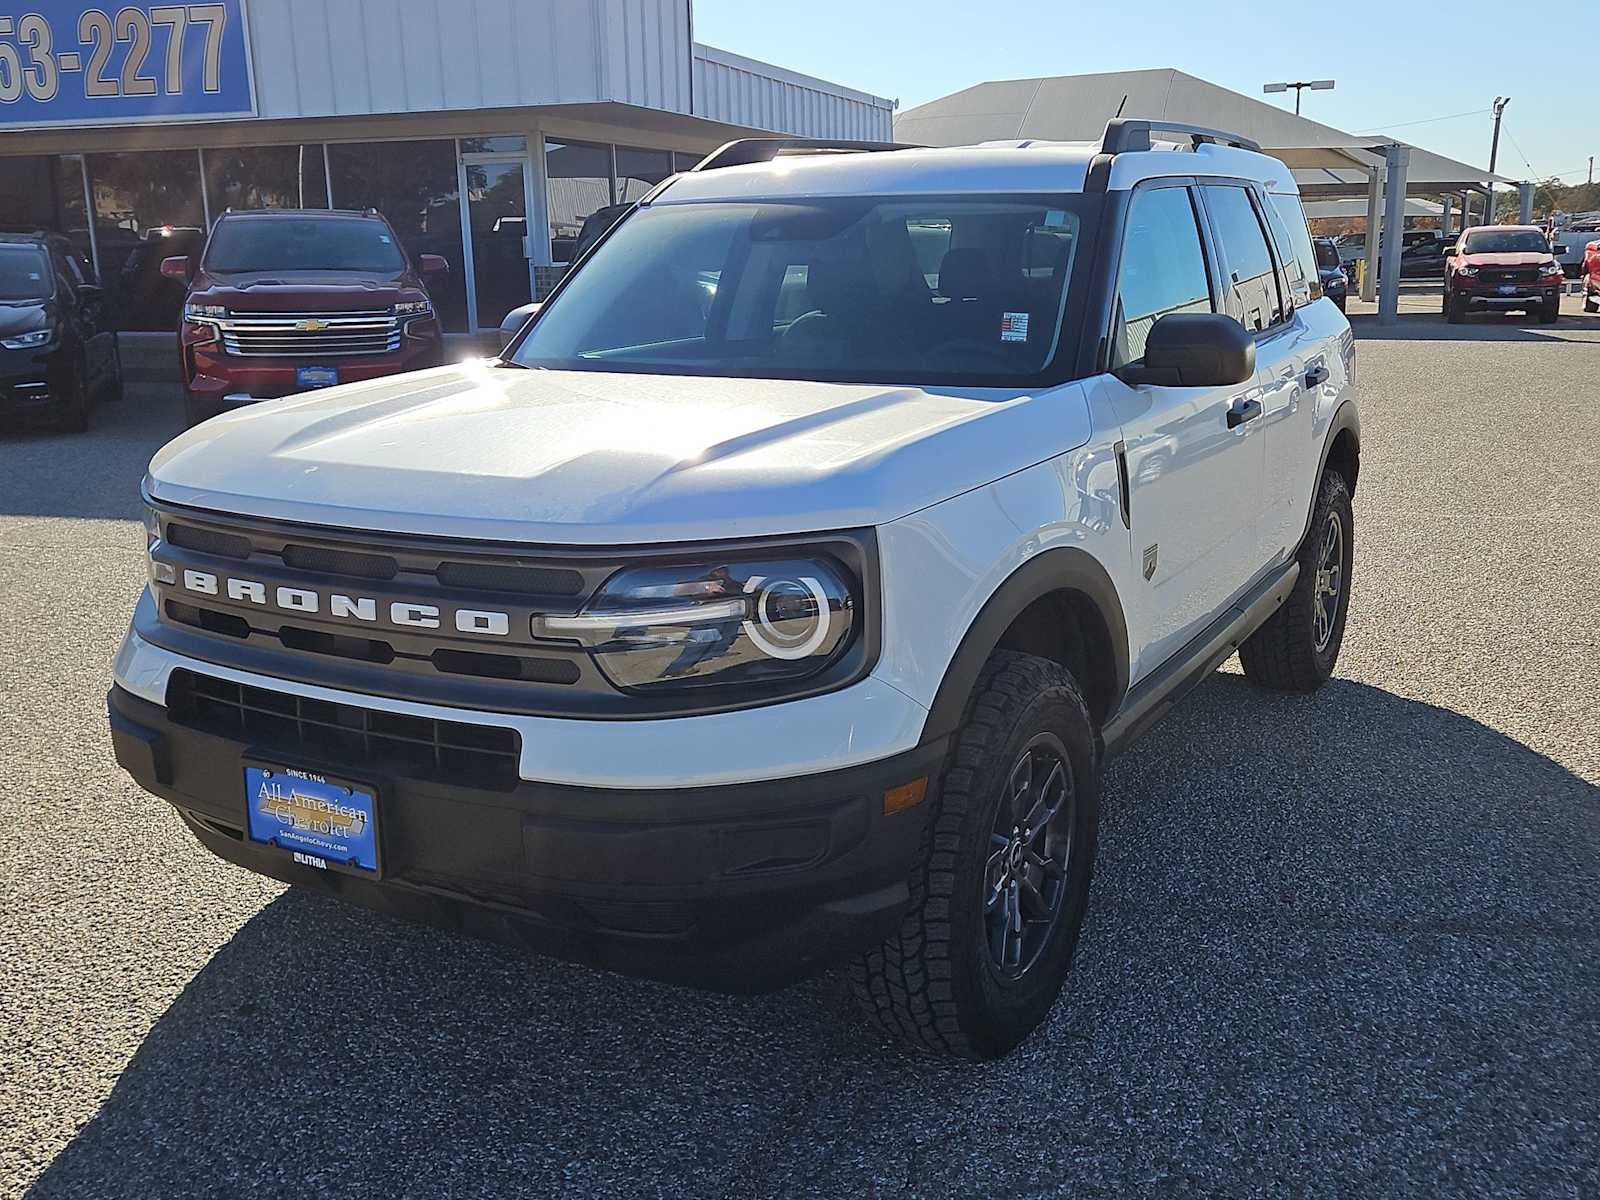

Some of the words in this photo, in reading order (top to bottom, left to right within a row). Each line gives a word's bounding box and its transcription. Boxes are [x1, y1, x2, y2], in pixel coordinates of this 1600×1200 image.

[183, 569, 509, 636] BRONCO
[286, 768, 308, 780] SINCE
[258, 781, 282, 802] All
[287, 787, 369, 823] American
[275, 805, 351, 839] Chevrolet
[279, 829, 348, 853] SanAngeloChevy.com
[301, 853, 327, 870] LITHIA
